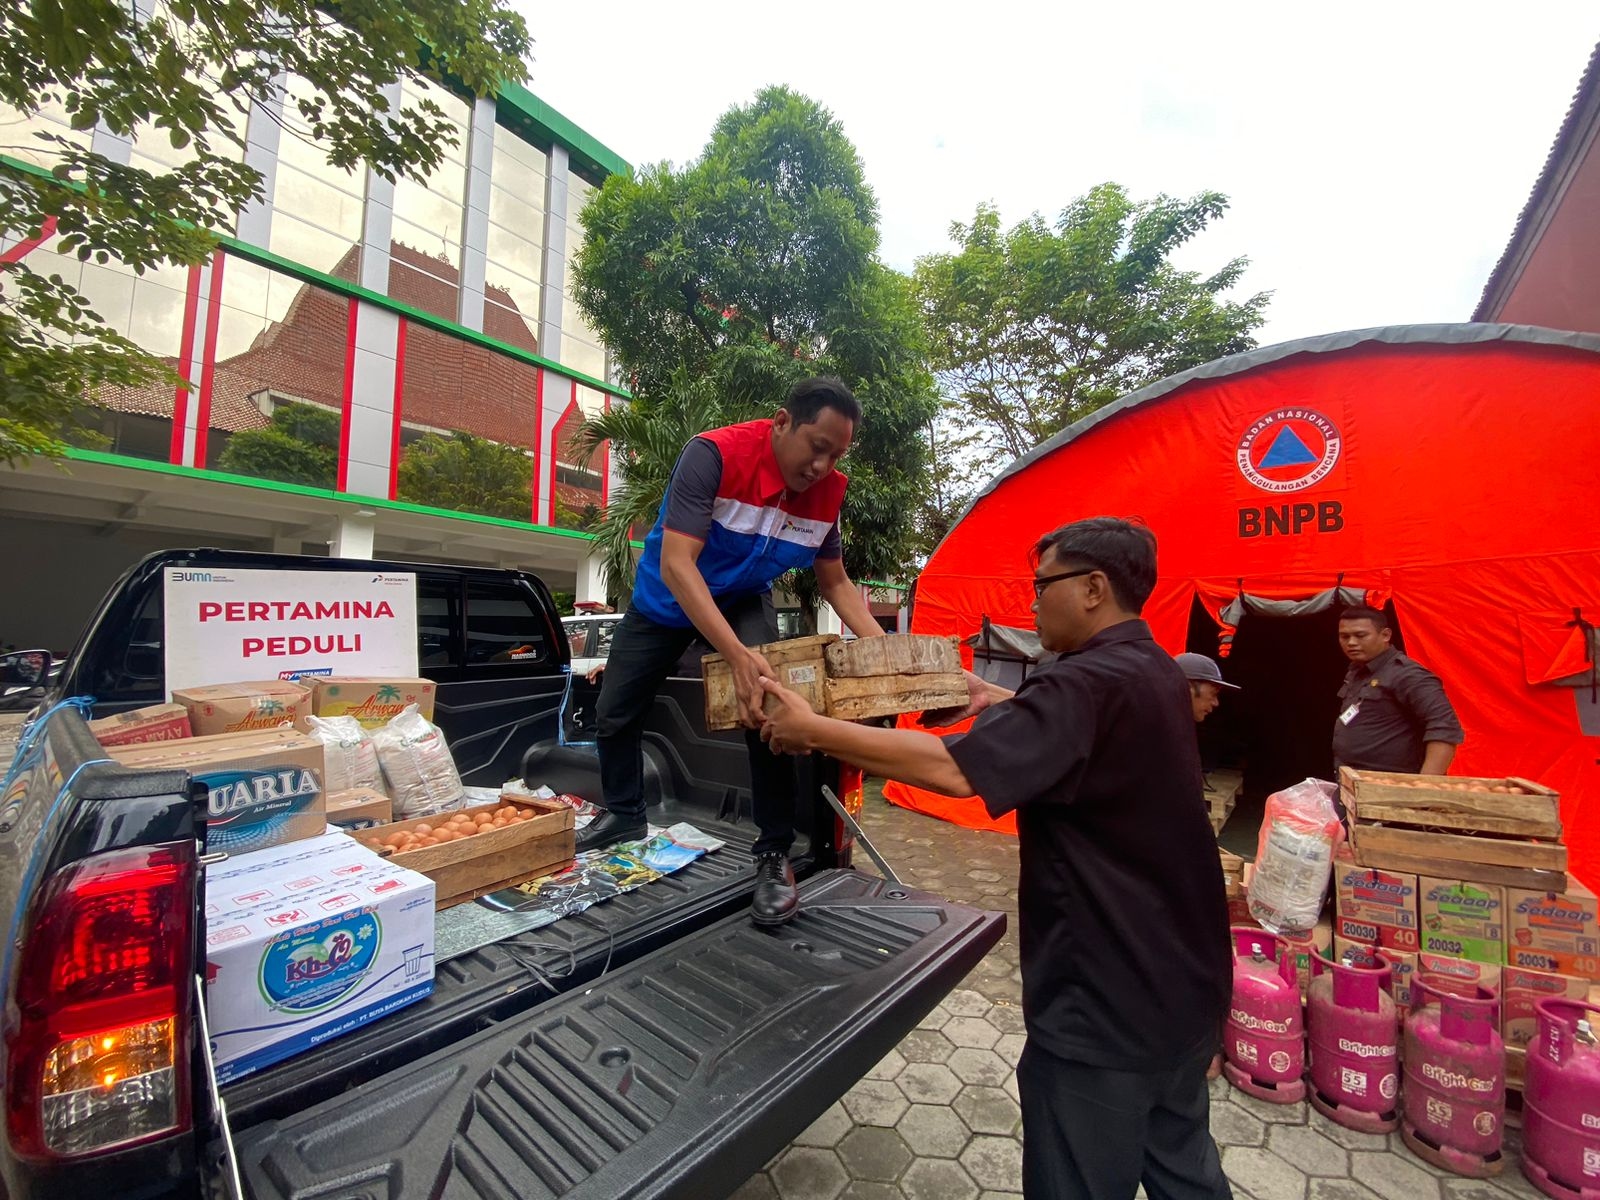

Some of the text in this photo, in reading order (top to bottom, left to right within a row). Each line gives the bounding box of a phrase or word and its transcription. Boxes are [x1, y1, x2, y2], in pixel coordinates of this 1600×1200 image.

[1241, 410, 1333, 447] BADAN NASIONAL
[1239, 442, 1337, 491] PENANGGULANGAN BENCANA
[1238, 500, 1344, 538] BNPB
[199, 600, 395, 622] PERTAMINA
[242, 633, 361, 658] PEDULI
[342, 694, 405, 718] Arwan
[208, 768, 322, 817] UARIA
[1343, 876, 1413, 897] Sedaap
[1427, 890, 1499, 910] Sedaap
[1401, 914, 1410, 925] 8
[1515, 903, 1594, 922] Sedaap
[1343, 922, 1416, 945] 20030 40
[1490, 928, 1498, 938] 8
[1428, 938, 1463, 954] 20032
[1583, 943, 1592, 953] 8
[1573, 957, 1596, 973] 40
[1231, 1009, 1288, 1034] Bright Gas
[1339, 1038, 1380, 1057] Bright
[1422, 1063, 1494, 1092] Bright Gas
